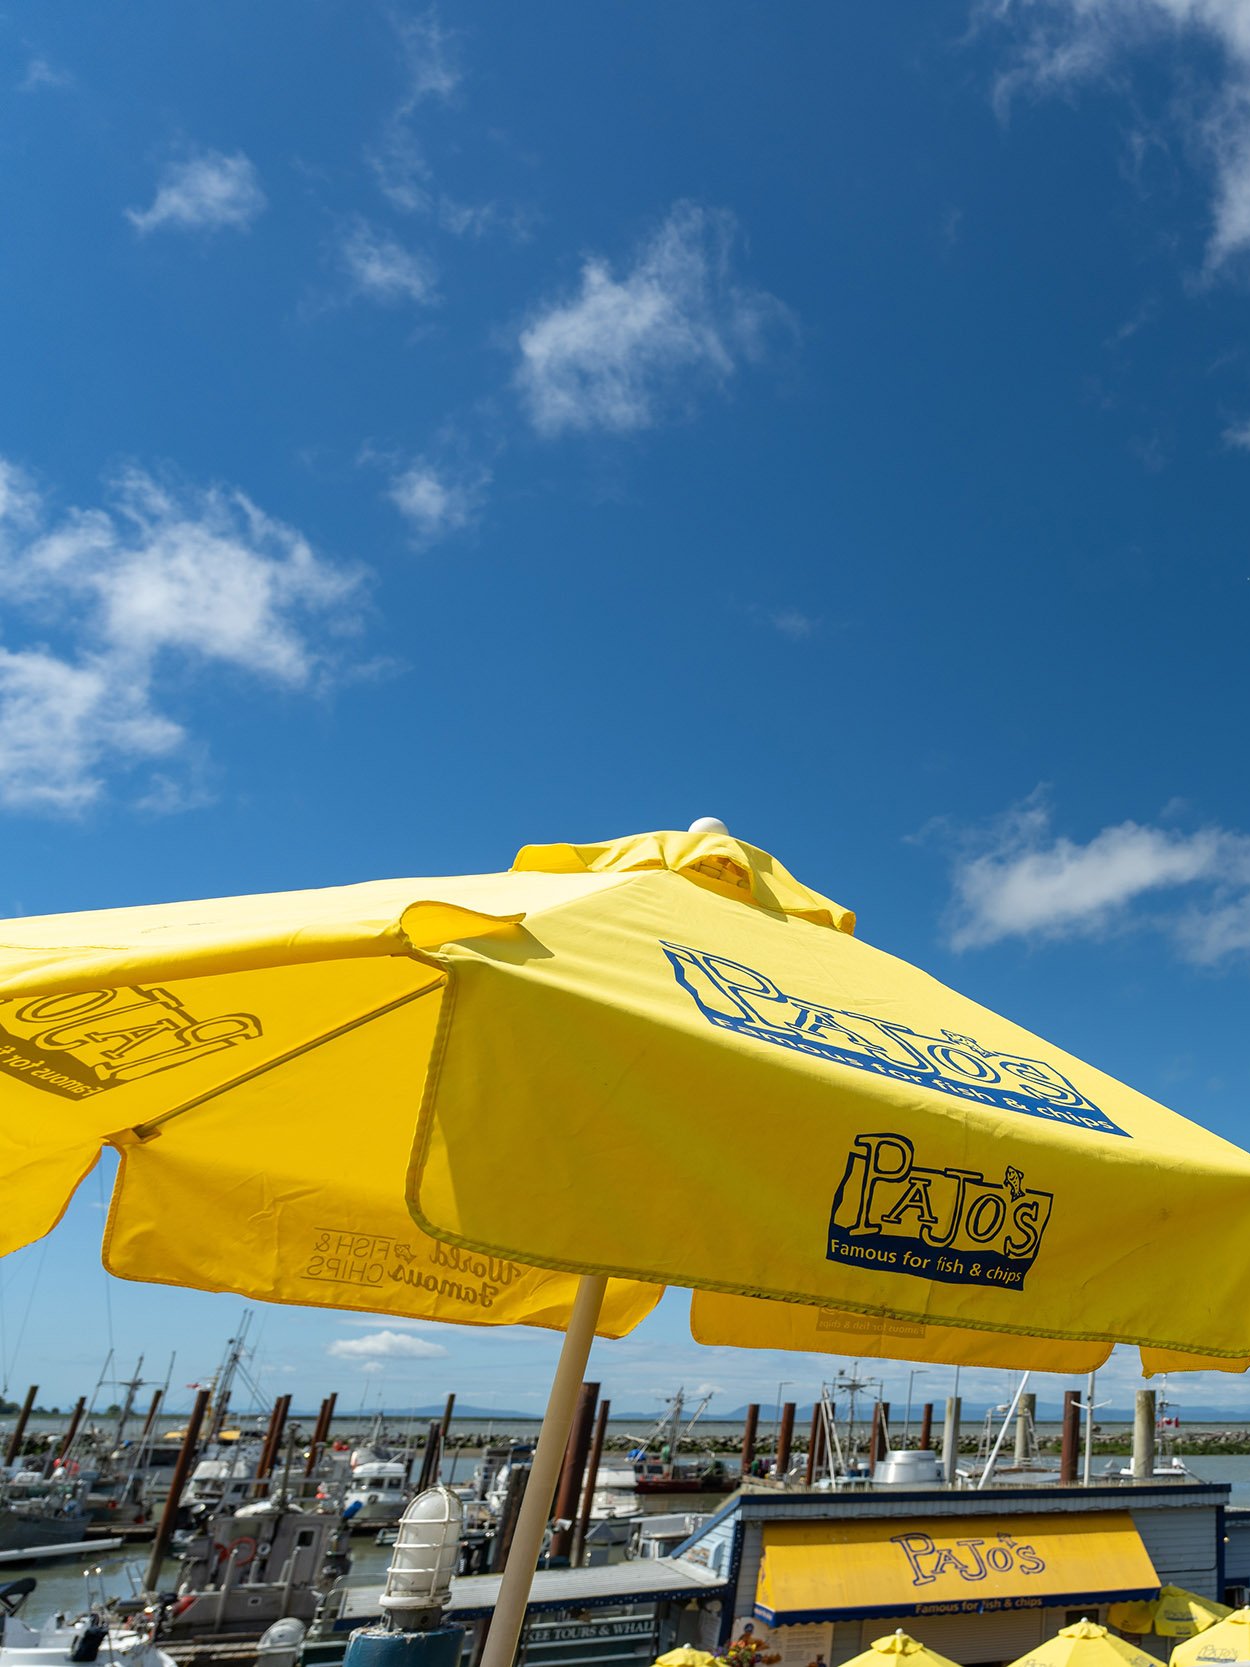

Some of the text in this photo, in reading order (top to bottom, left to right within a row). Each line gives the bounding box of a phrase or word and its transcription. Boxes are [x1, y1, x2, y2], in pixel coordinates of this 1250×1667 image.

[659, 940, 1084, 1106] PAJO'S
[712, 1016, 1115, 1130] Famous for fish & chips
[849, 1133, 1039, 1257] PAJO'S
[830, 1239, 1023, 1284] Famous for fish & chips
[890, 1531, 1046, 1587] PAJO'S
[553, 1626, 598, 1640] TOURS
[599, 1625, 610, 1636] &
[916, 1602, 959, 1614] Famous
[962, 1601, 978, 1611] for
[1004, 1598, 1013, 1608] &
[1015, 1596, 1042, 1607] chips
